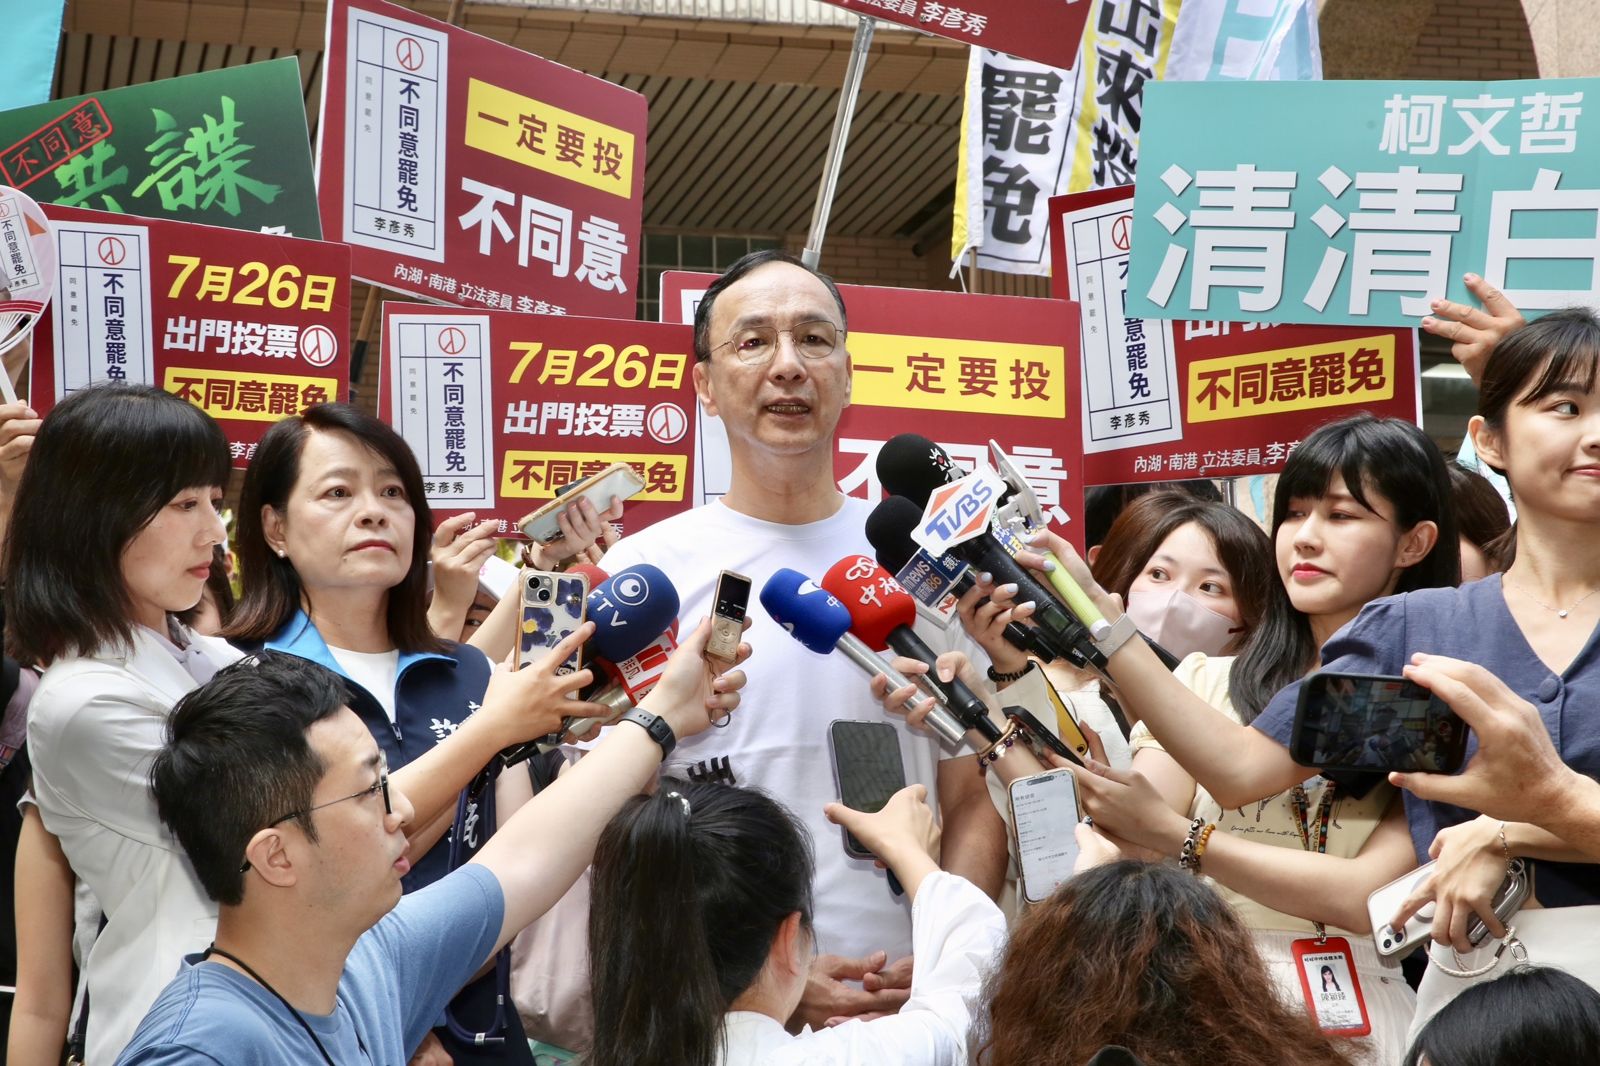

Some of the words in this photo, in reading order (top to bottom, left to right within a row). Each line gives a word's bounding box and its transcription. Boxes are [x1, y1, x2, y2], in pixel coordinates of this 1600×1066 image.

[858, 0, 918, 17] 委員
[919, 1, 988, 36] 李彥秀
[10, 110, 101, 178] 不同意
[397, 78, 421, 213] 不同意罷免
[478, 110, 623, 181] 一定要投
[982, 50, 1064, 245] 罷免
[1378, 92, 1584, 156] 柯文哲
[53, 95, 284, 217] 共諜
[1, 219, 27, 276] 不同意罷免
[373, 216, 416, 238] 李彥秀
[458, 176, 628, 294] 不同意
[1146, 163, 1600, 317] 清清白
[167, 255, 336, 312] 7月26日
[460, 283, 513, 311] 立法委員
[103, 273, 127, 384] 不同意罷免
[163, 316, 299, 359] 出門投票
[1118, 260, 1151, 400] 意罷免
[508, 341, 688, 389] 7月26日
[852, 352, 1052, 402] 一定要投
[1196, 347, 1386, 411] 不同意罷免
[172, 376, 328, 416] 不同意罷免
[442, 362, 467, 473] 不同意罷免
[503, 400, 648, 438] 出門投票
[1110, 411, 1151, 430] 李彥秀
[510, 459, 679, 494] 不同免
[836, 437, 1072, 527] 不意
[1202, 448, 1261, 469] 立法委員
[424, 481, 465, 494] 李彥秀
[924, 478, 993, 541] TVBS
[859, 576, 909, 608] 中視
